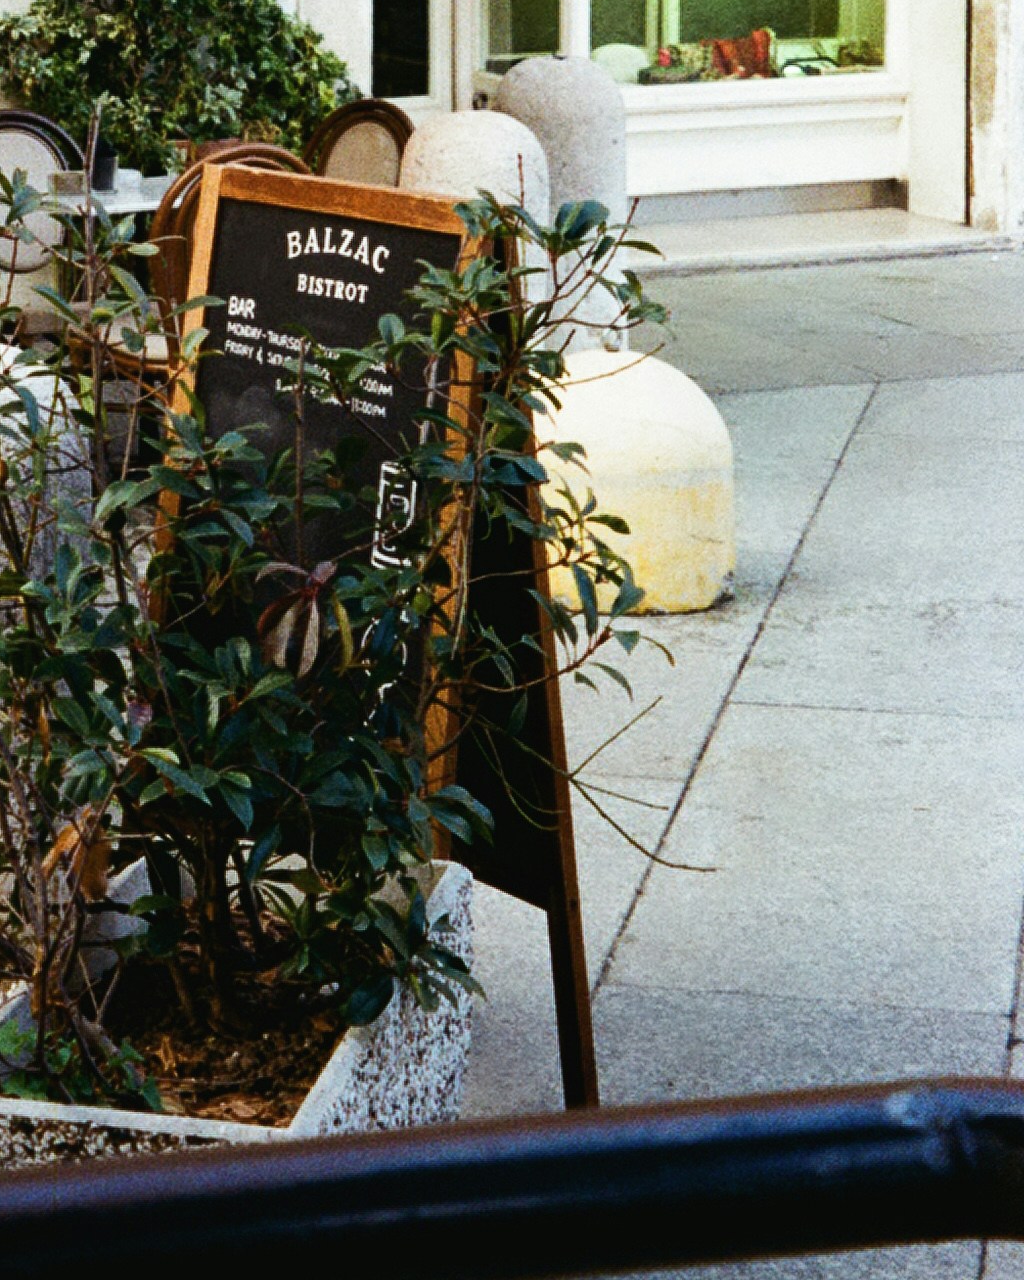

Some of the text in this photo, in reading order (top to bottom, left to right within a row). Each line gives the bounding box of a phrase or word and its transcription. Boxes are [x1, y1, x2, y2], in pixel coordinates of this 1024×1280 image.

[286, 226, 391, 274] BALZAC
[296, 273, 369, 304] BISTROT
[227, 295, 256, 319] BAR
